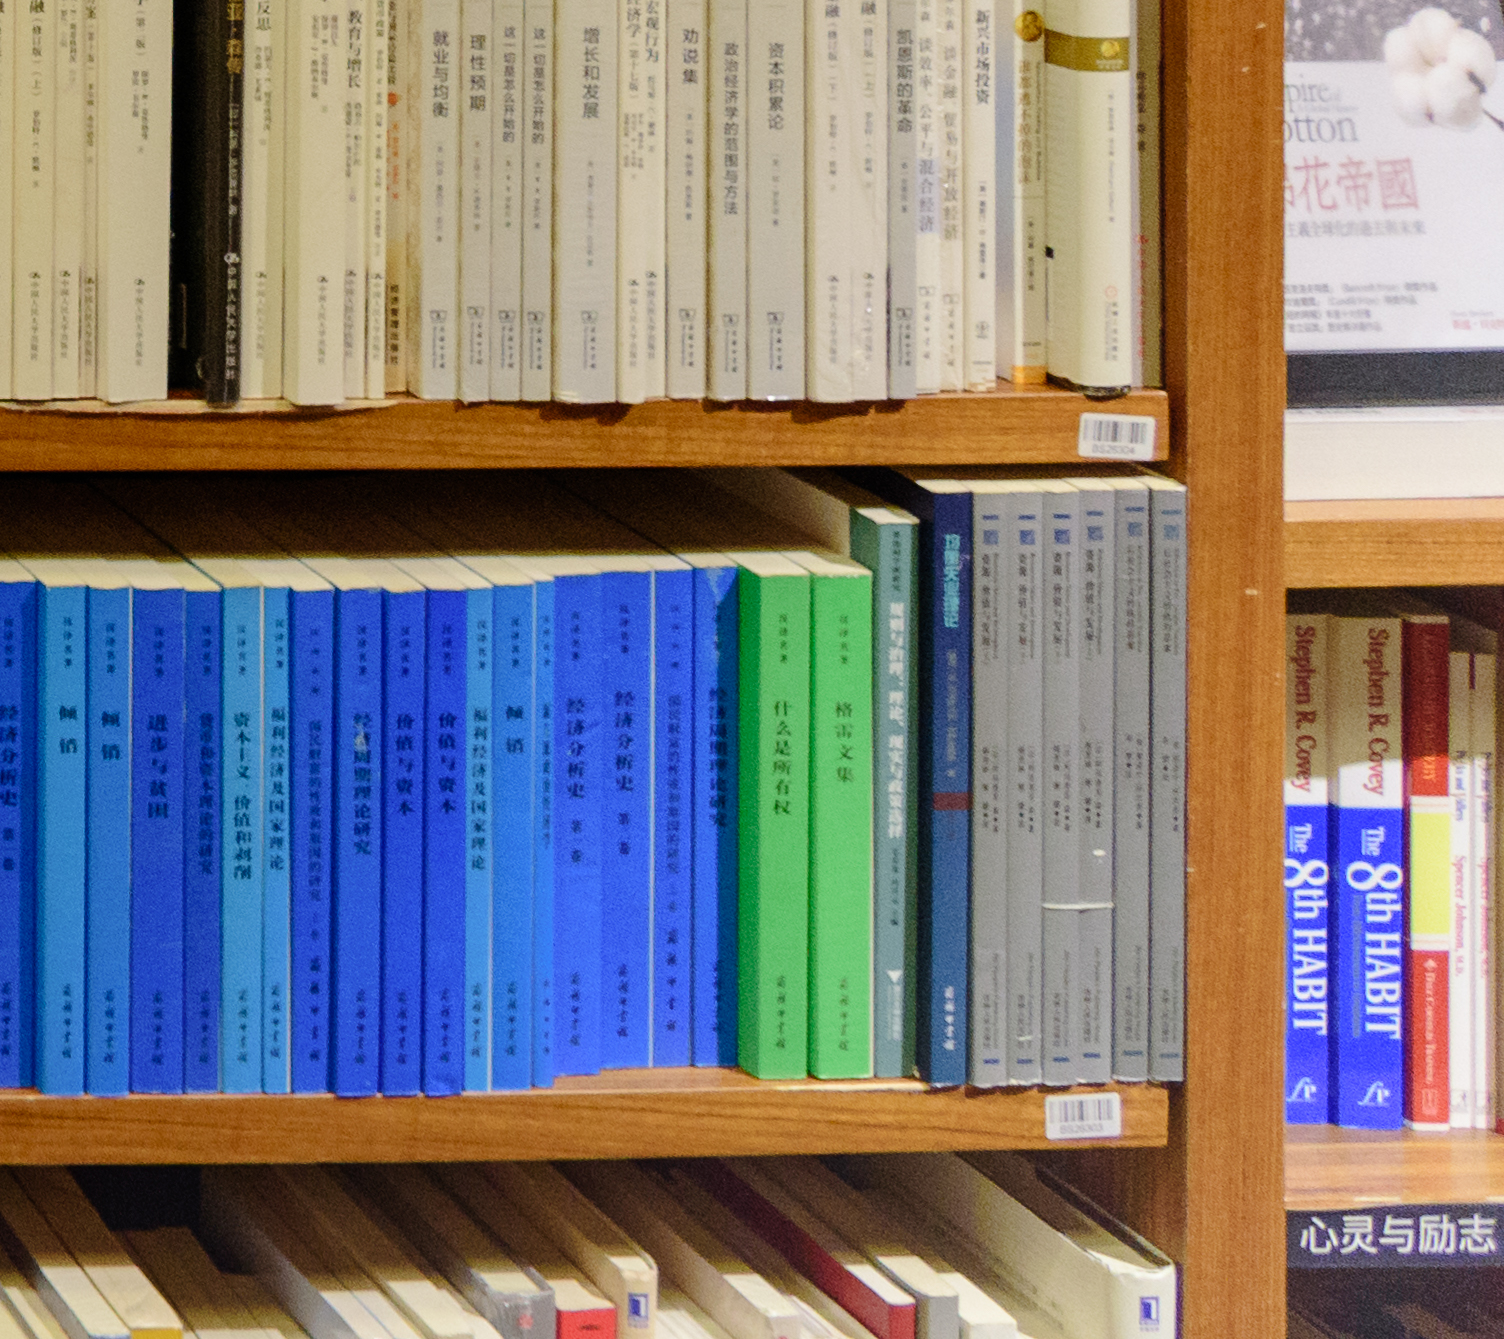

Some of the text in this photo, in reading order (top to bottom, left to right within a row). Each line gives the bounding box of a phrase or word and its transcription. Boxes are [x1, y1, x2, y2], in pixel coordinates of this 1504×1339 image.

[1363, 628, 1388, 706] Stephen
[1363, 737, 1388, 795] Covey
[1346, 826, 1403, 1040] The 8th HABIT
[1300, 1216, 1498, 1255] 心灵与励志
